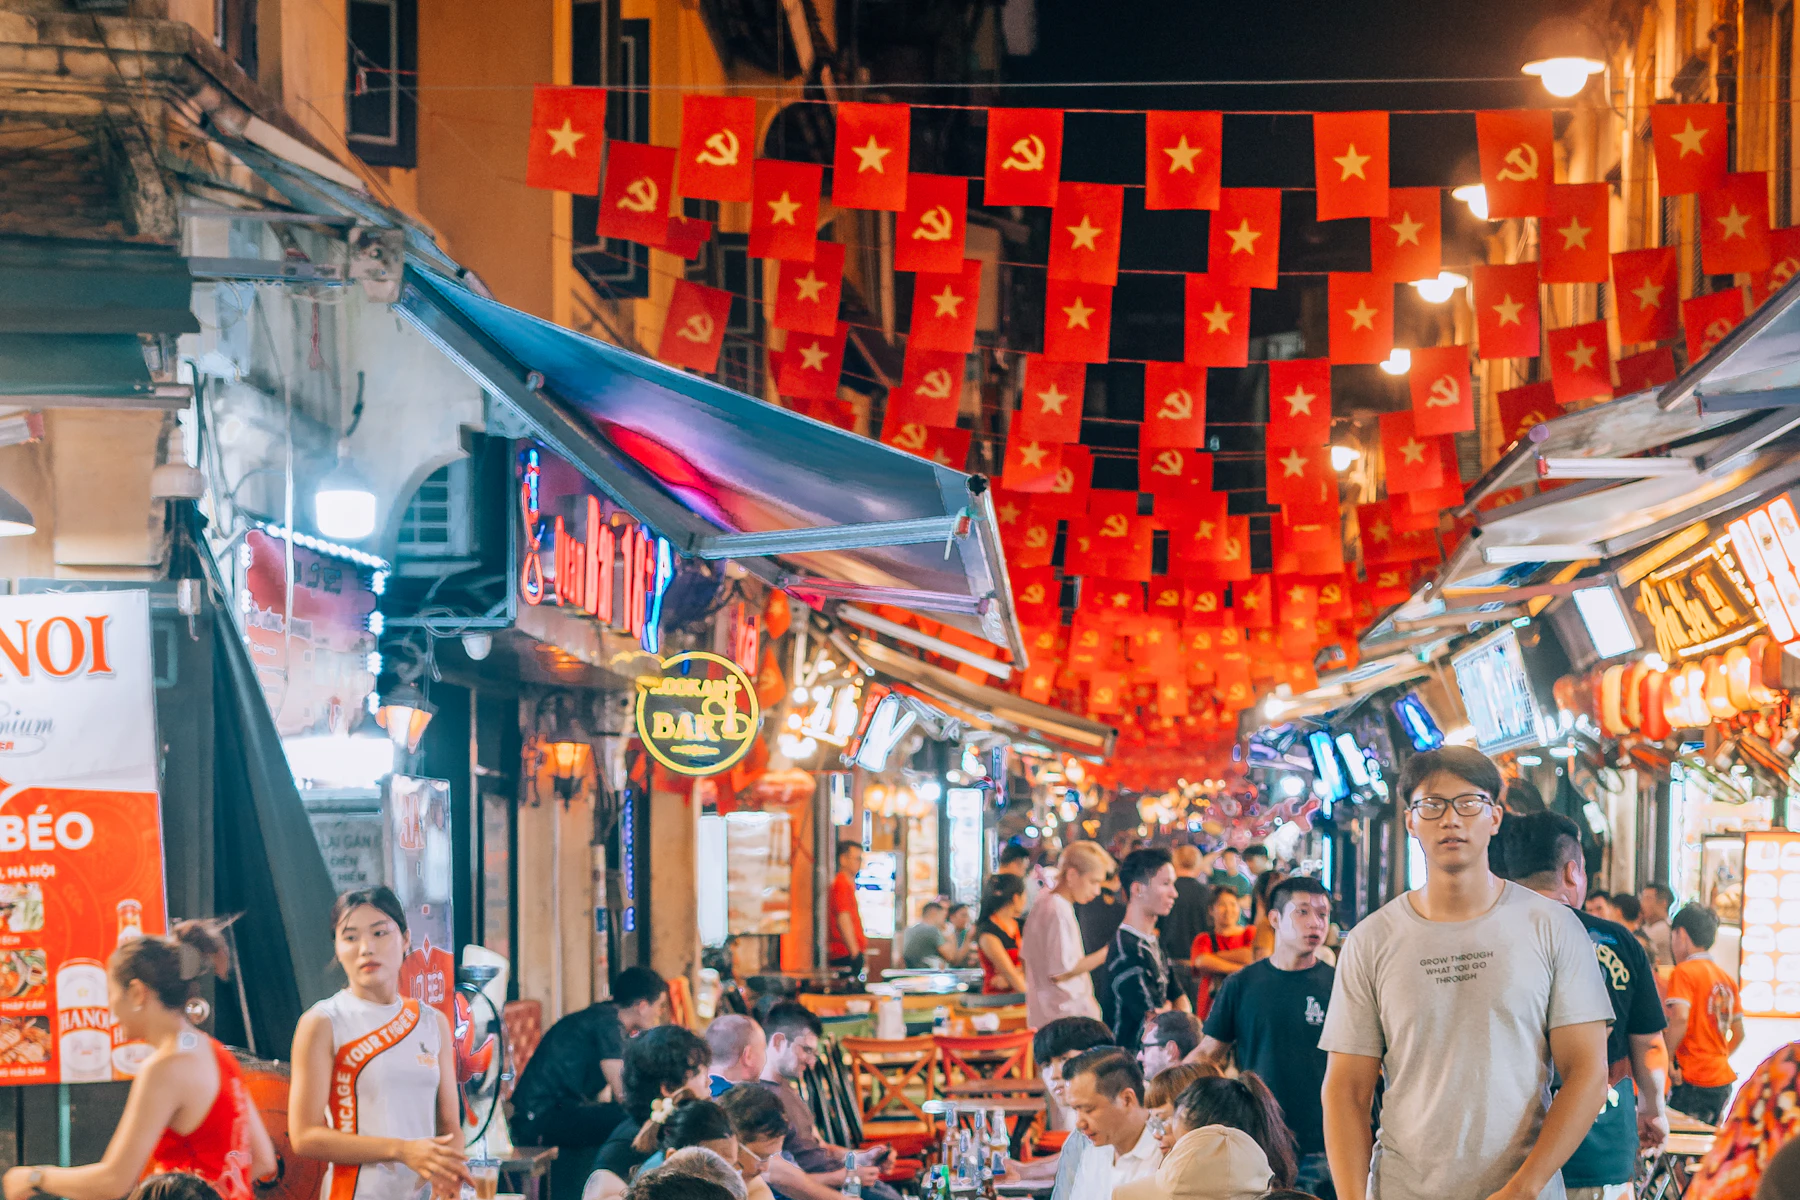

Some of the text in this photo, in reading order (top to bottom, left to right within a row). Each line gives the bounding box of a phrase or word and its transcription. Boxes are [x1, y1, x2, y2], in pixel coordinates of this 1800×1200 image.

[652, 711, 721, 741] BAR
[0, 804, 94, 852] BÉO
[1420, 951, 1494, 967] GROW THROUGH
[1425, 961, 1487, 975] WHAT YOU GO
[1435, 973, 1478, 985] THROUGH
[1304, 995, 1325, 1024] LA
[343, 1034, 384, 1069] YOUR
[380, 1008, 417, 1043] TIGER
